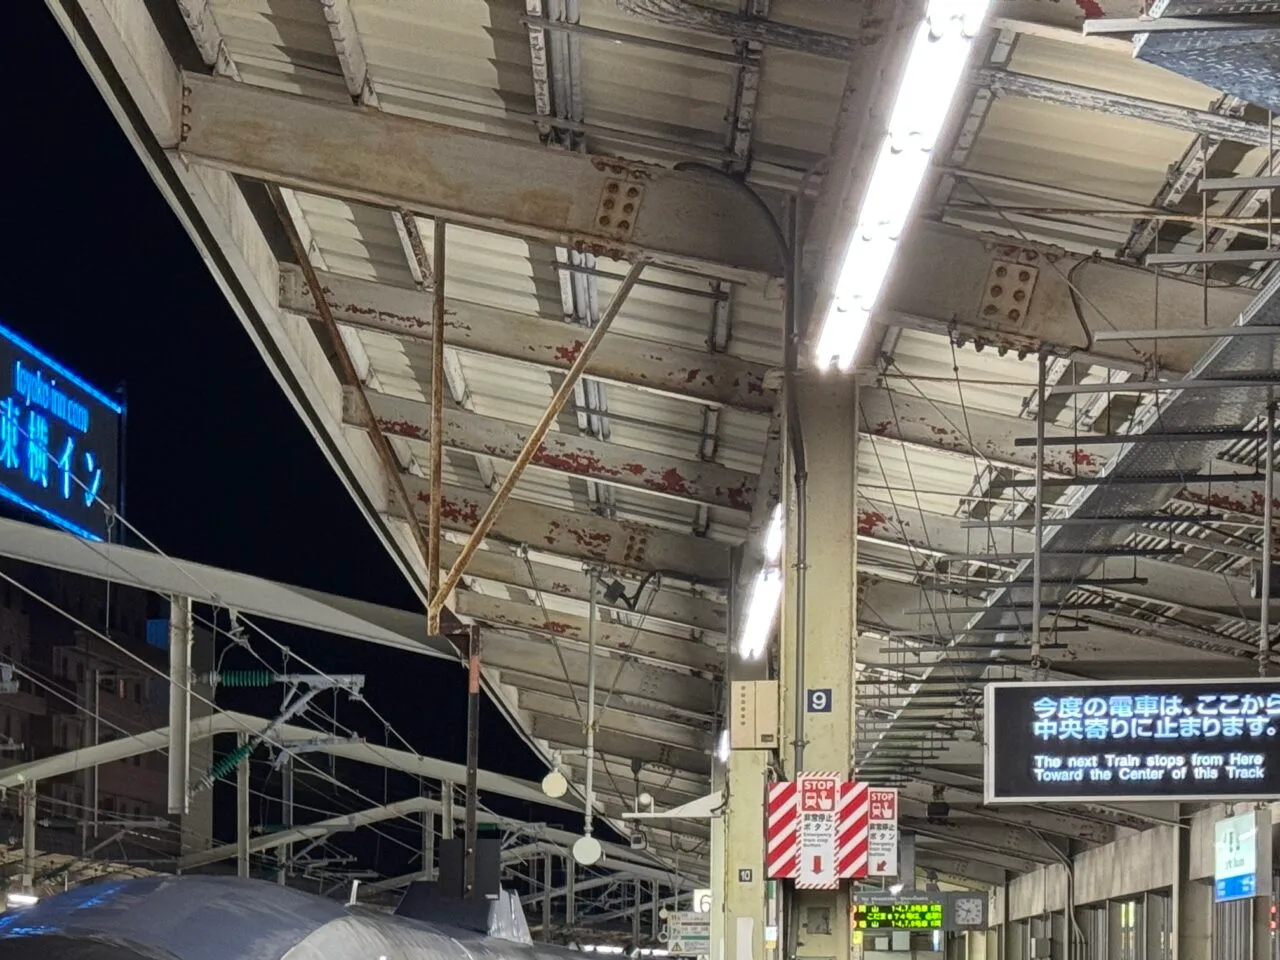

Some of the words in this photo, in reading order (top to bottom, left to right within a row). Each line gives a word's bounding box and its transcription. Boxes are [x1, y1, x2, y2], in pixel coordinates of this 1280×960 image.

[812, 691, 826, 710] 9
[1033, 715, 1276, 740] 中央寄りに止まります。
[1034, 755, 1061, 768] The
[1068, 754, 1097, 767] next
[1105, 754, 1140, 767] Train
[1147, 753, 1184, 768] stops
[1191, 753, 1222, 766] from
[1230, 752, 1263, 765] Here
[1034, 768, 1082, 781] Toward
[1090, 768, 1112, 780] the
[1119, 768, 1164, 781] Center
[1172, 767, 1187, 780] of
[1194, 766, 1218, 780] this
[1226, 766, 1264, 779] Track
[804, 781, 834, 790] STOP
[871, 793, 894, 801] STOP
[804, 813, 833, 822] 非常停止
[803, 823, 832, 831] ボタン
[740, 871, 750, 880] 10
[700, 894, 711, 912] 6
